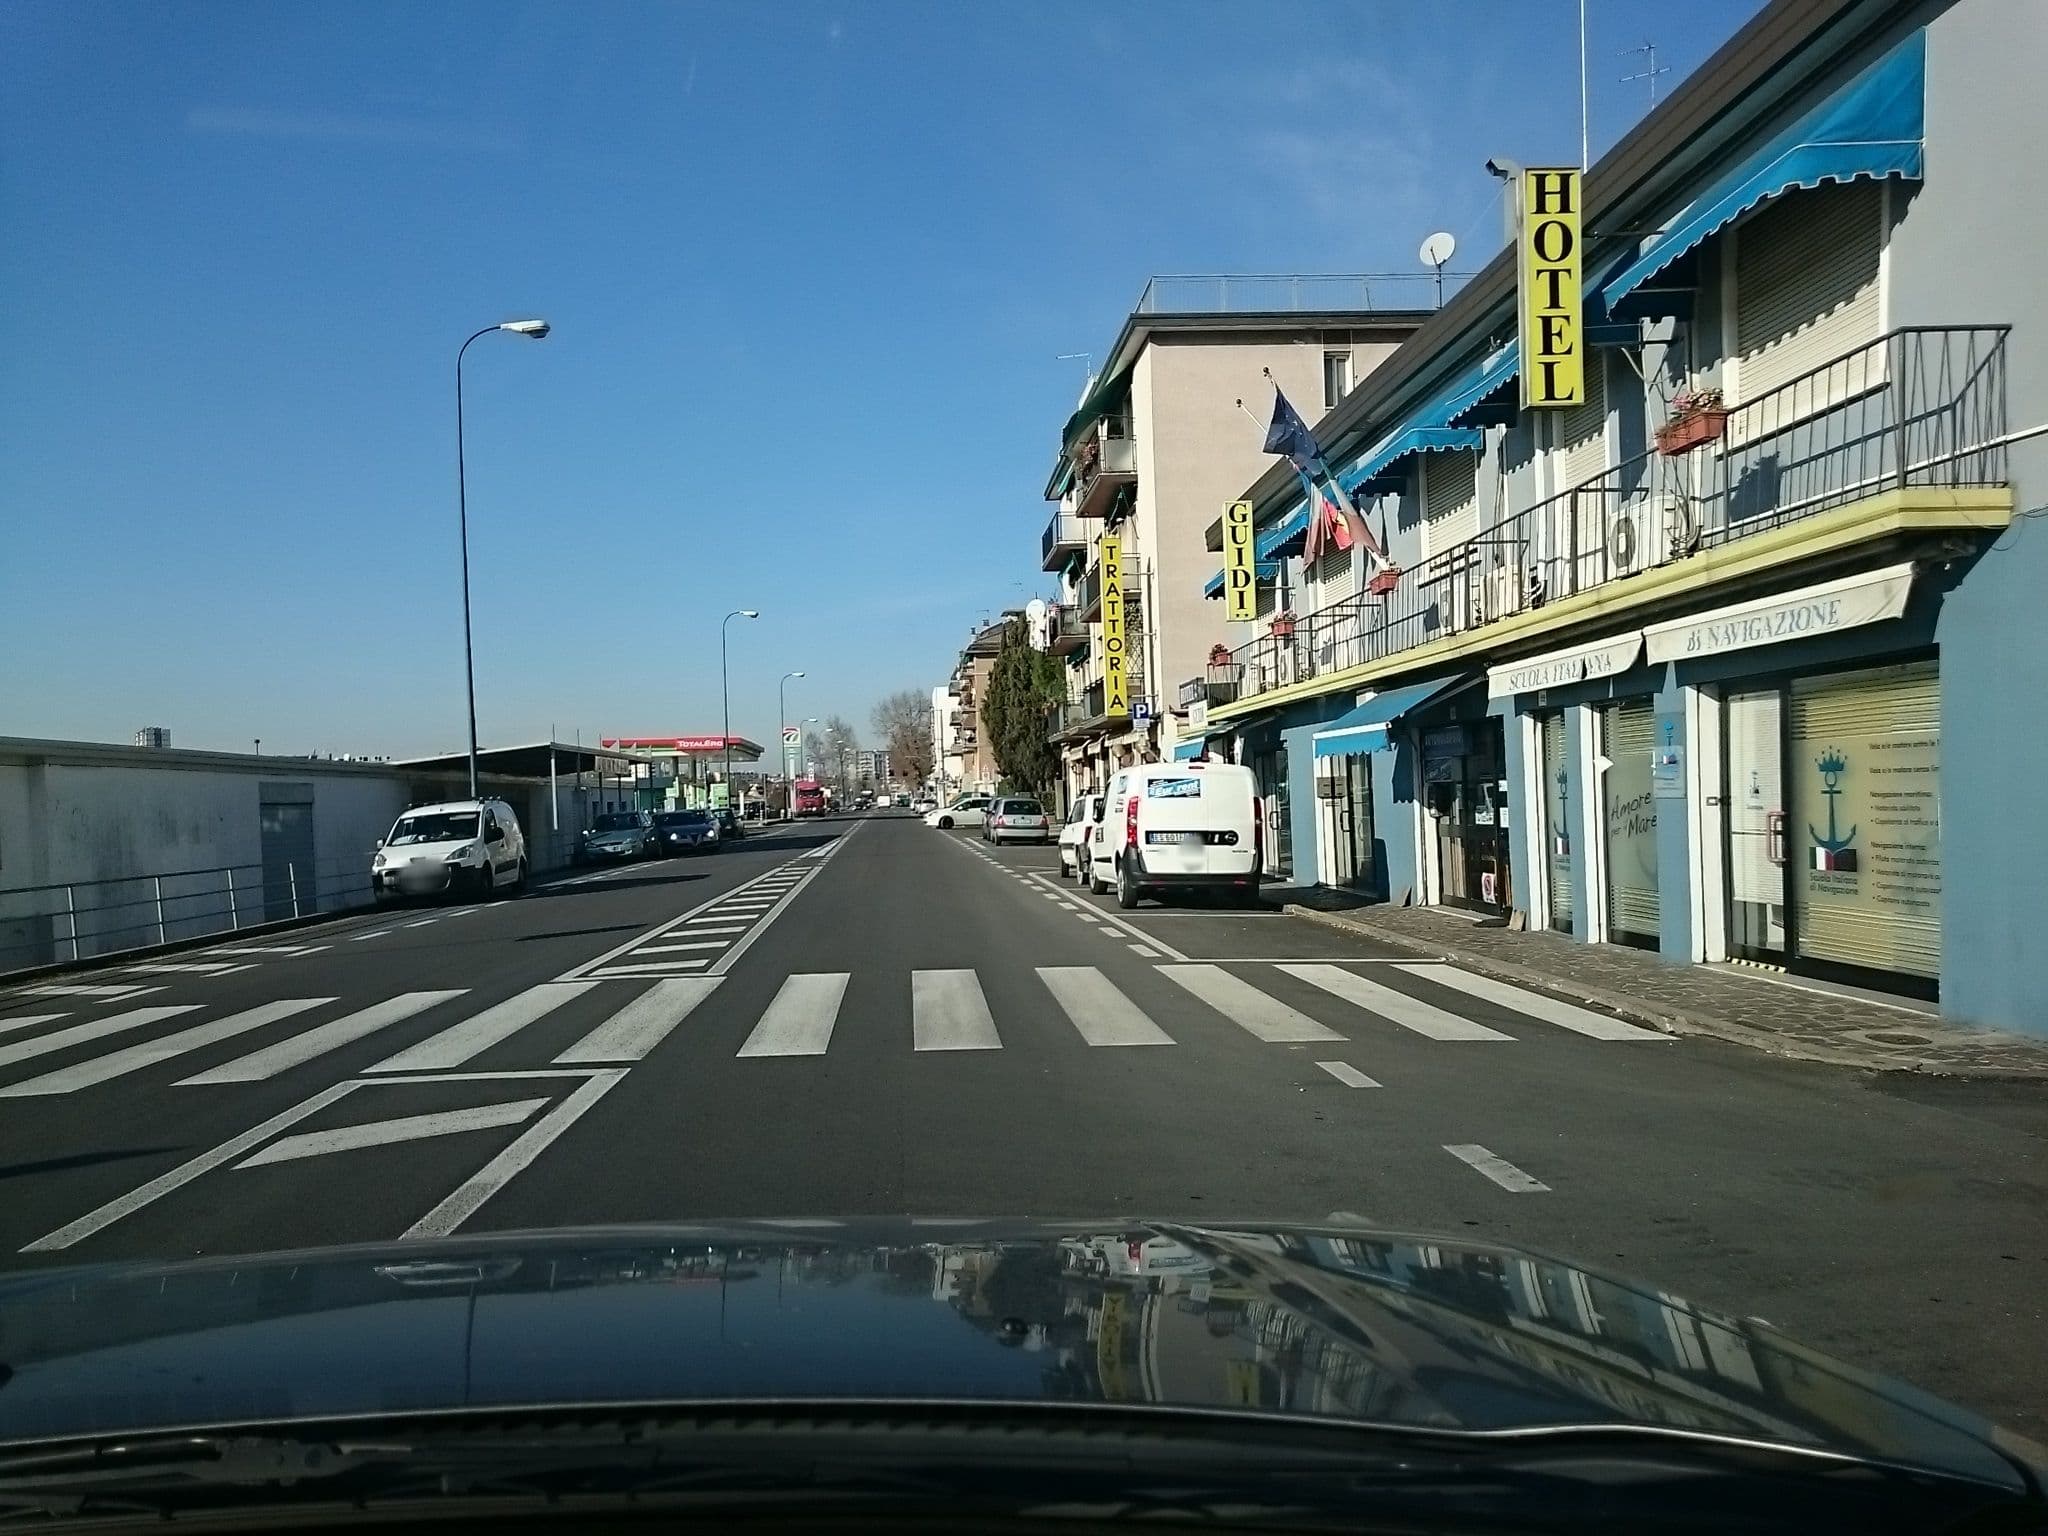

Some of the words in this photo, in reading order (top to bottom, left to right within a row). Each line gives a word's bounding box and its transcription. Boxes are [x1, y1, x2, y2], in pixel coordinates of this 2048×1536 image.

[1530, 173, 1576, 402] HOTEL
[1228, 502, 1251, 610] GUIDI
[1105, 545, 1125, 709] TRATTORIA
[1686, 628, 1701, 652] di
[1707, 599, 1842, 650] NAVIGAZIONE
[1508, 666, 1549, 691] SCUOLA
[1135, 704, 1147, 718] P
[1611, 792, 1652, 821] Amore
[1627, 814, 1658, 838] Mare
